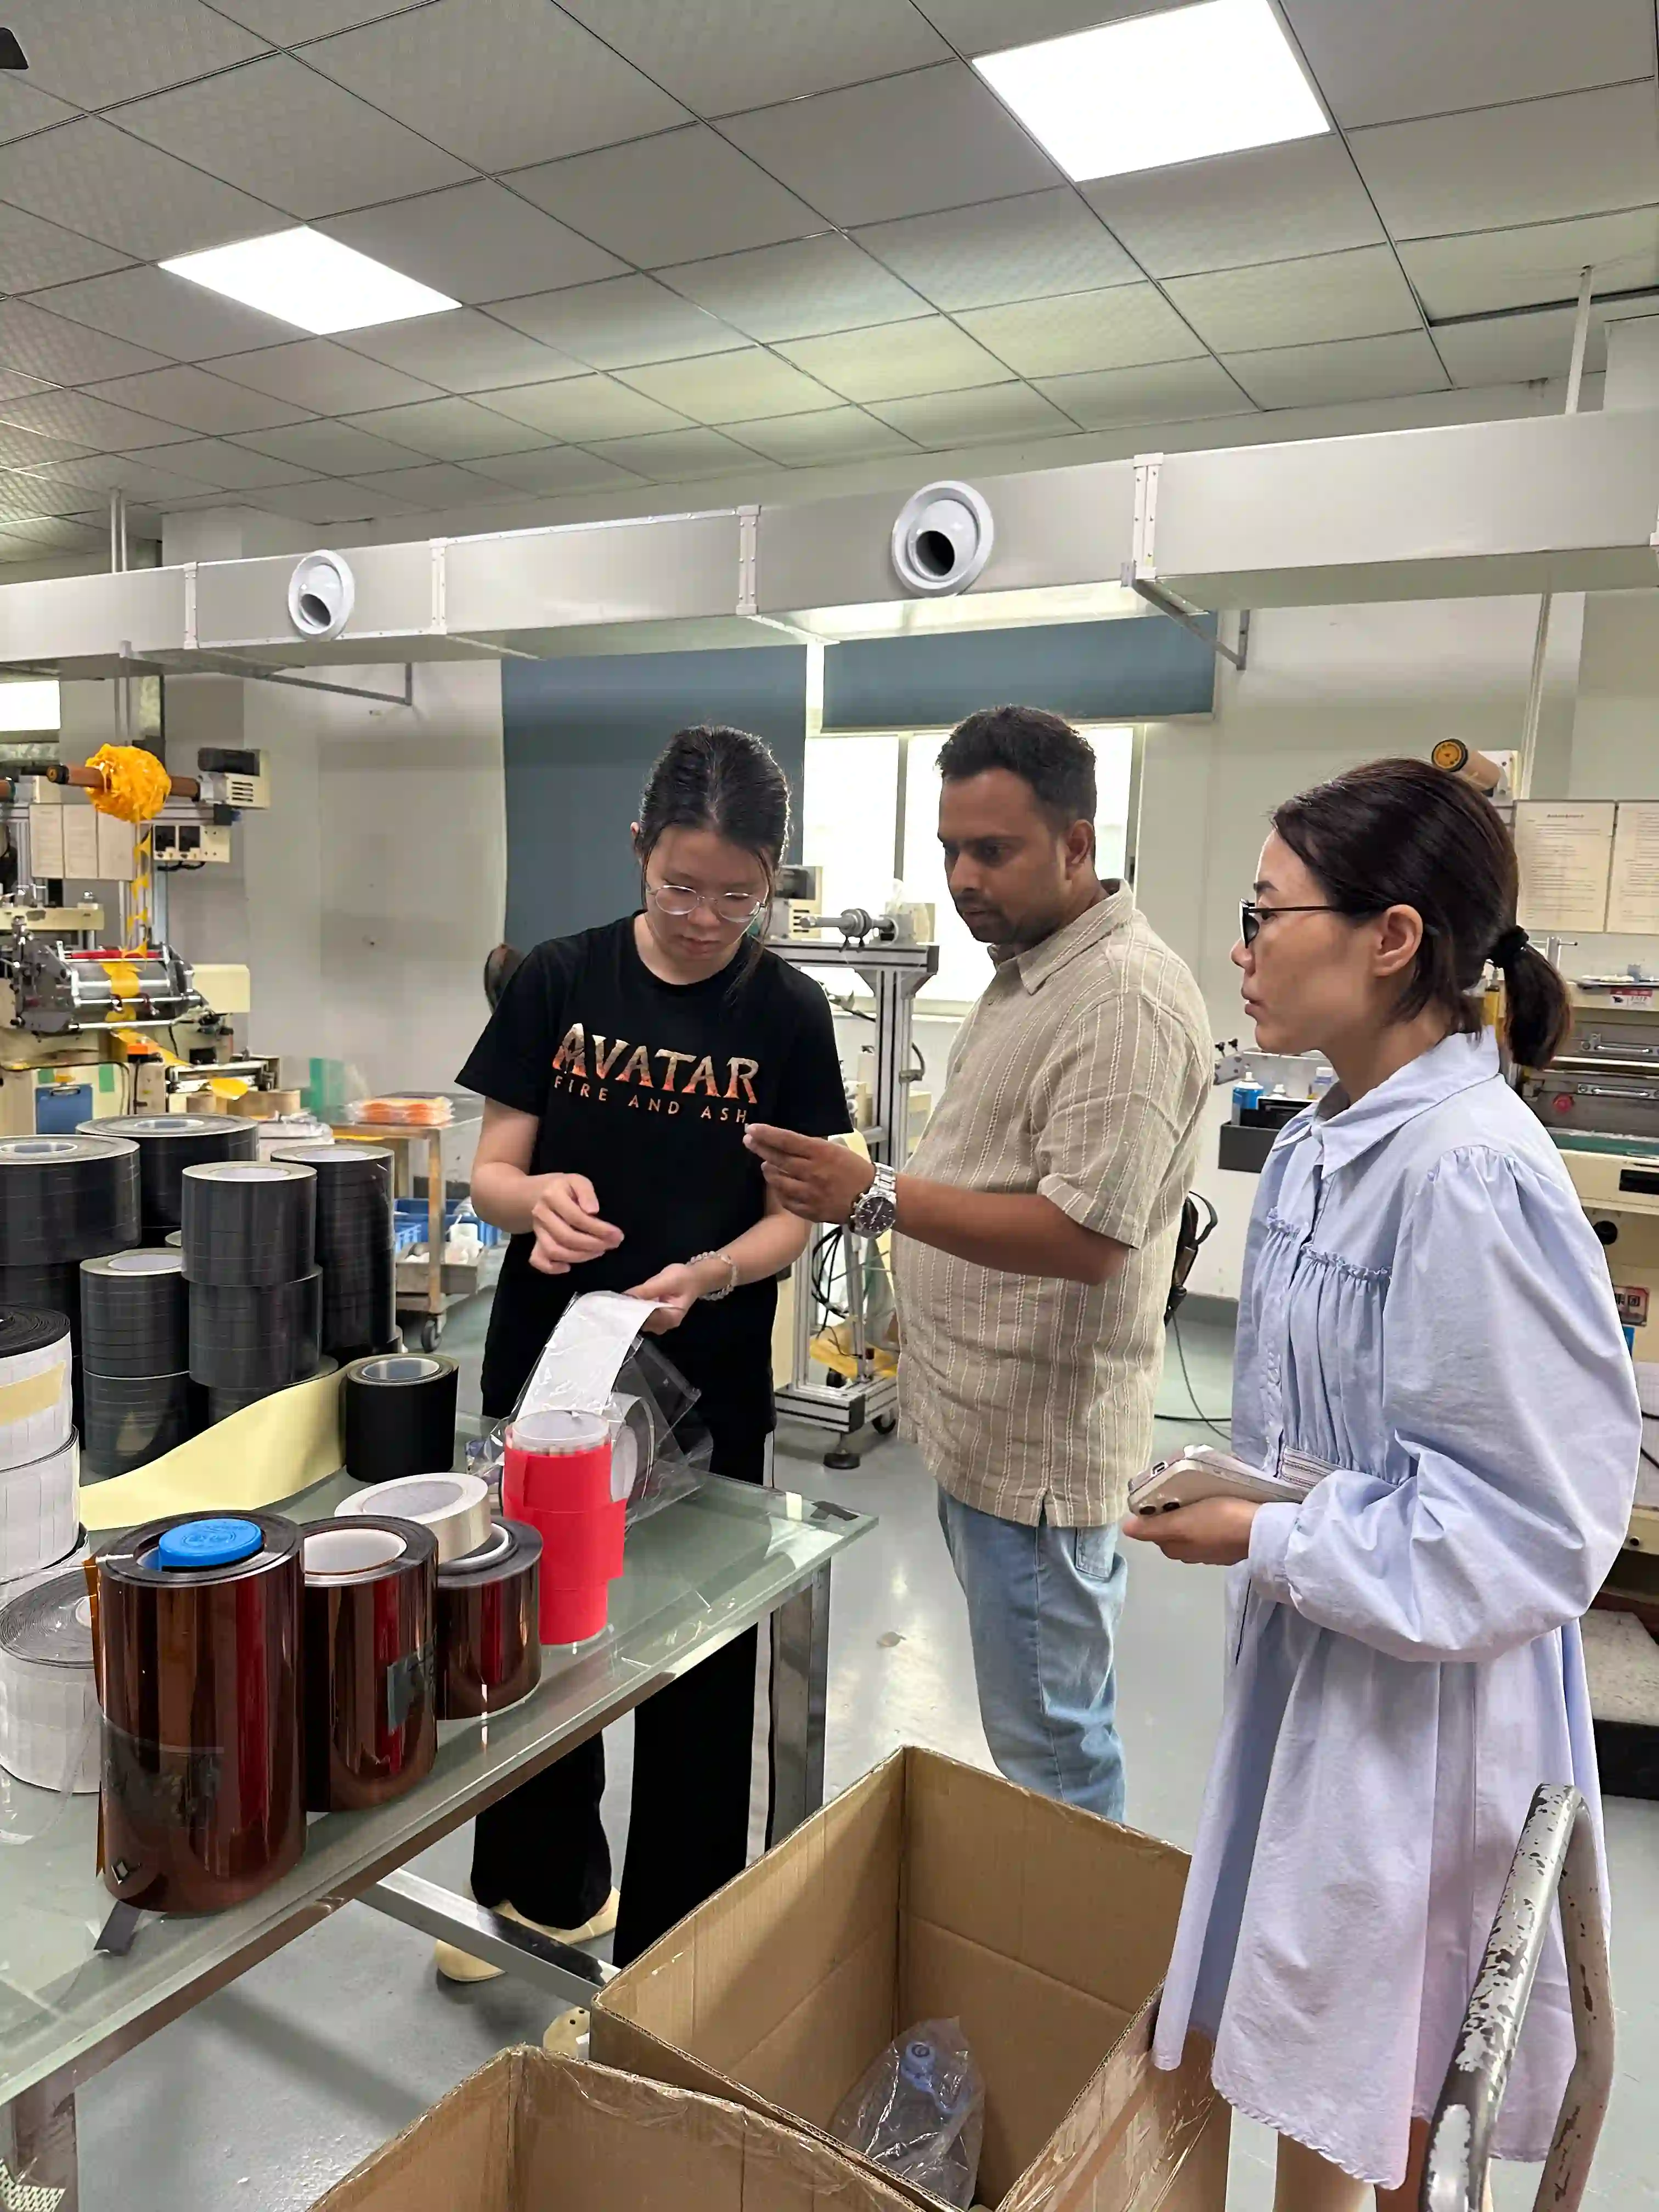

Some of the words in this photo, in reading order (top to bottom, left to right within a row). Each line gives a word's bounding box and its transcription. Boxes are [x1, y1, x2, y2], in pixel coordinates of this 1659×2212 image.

[552, 1023, 759, 1104] AVATAR
[554, 1075, 607, 1101] FIRE
[628, 1094, 680, 1115] AND
[701, 1105, 747, 1124] ASH
